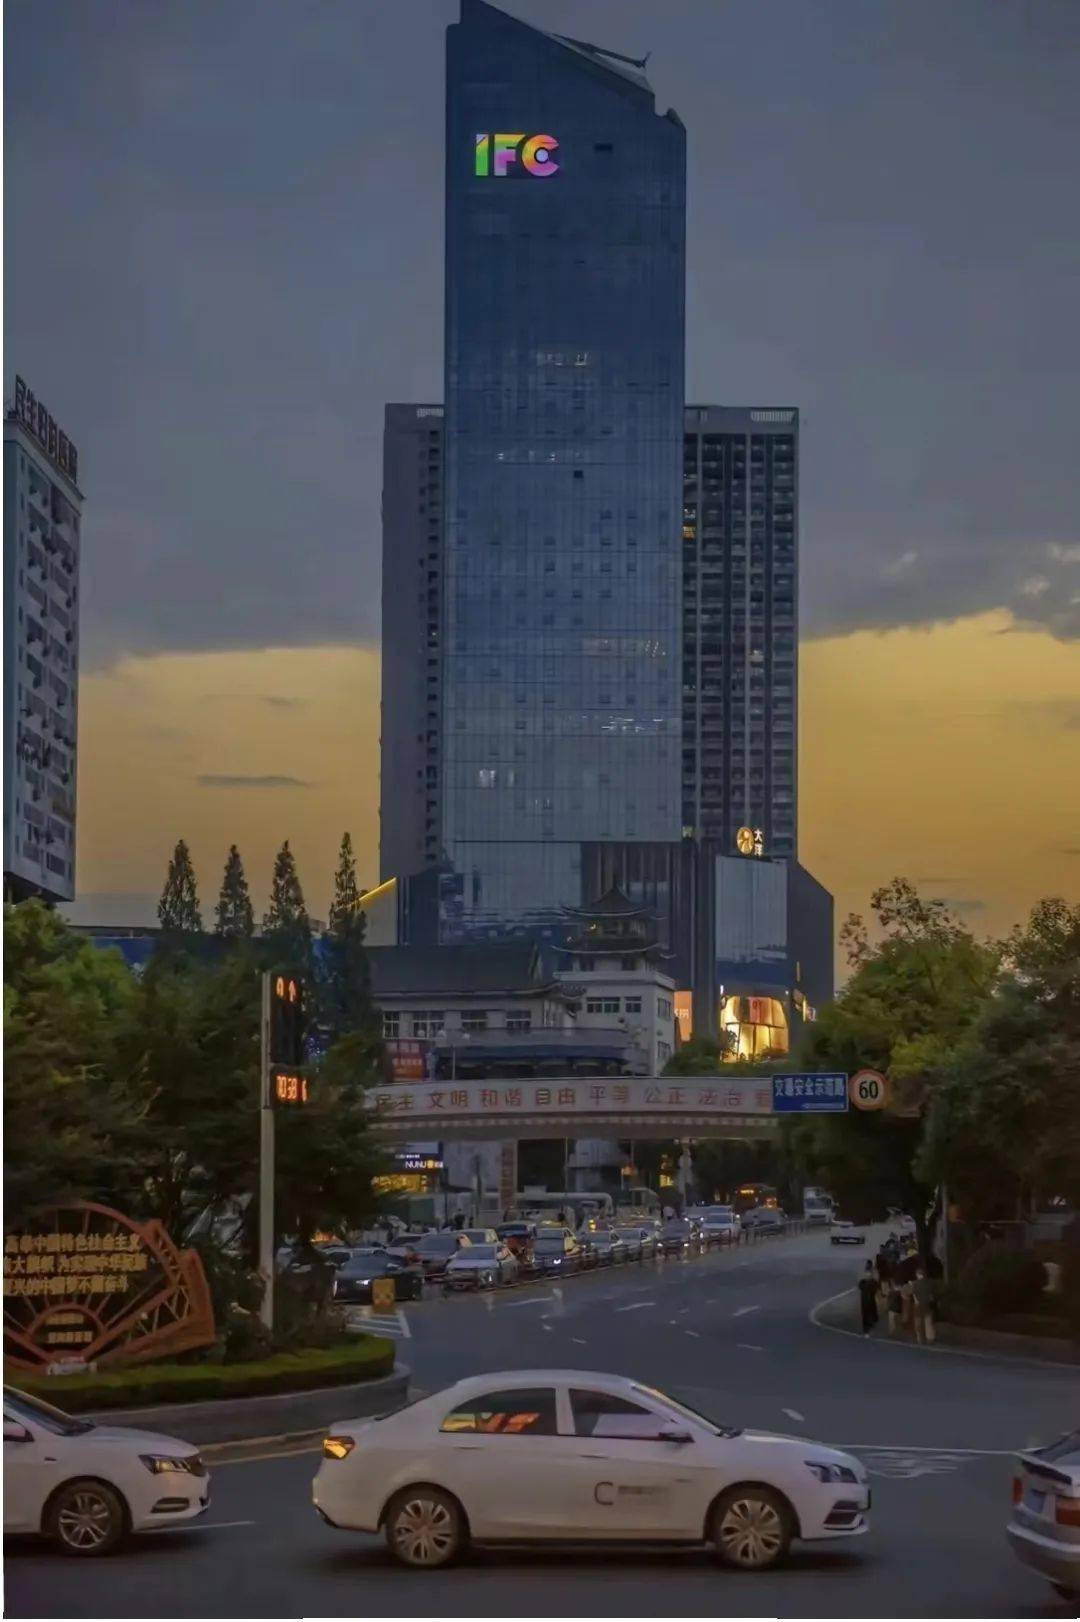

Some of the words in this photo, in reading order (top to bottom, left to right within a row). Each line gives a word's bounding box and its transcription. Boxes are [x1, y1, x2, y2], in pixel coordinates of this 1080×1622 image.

[475, 134, 559, 176] IFC
[428, 1090, 468, 1110] 文明
[480, 1088, 522, 1107] 和谐
[535, 1088, 577, 1106] 自由
[590, 1084, 629, 1106] 平等
[644, 1087, 688, 1106] 公正
[858, 1080, 879, 1099] 60
